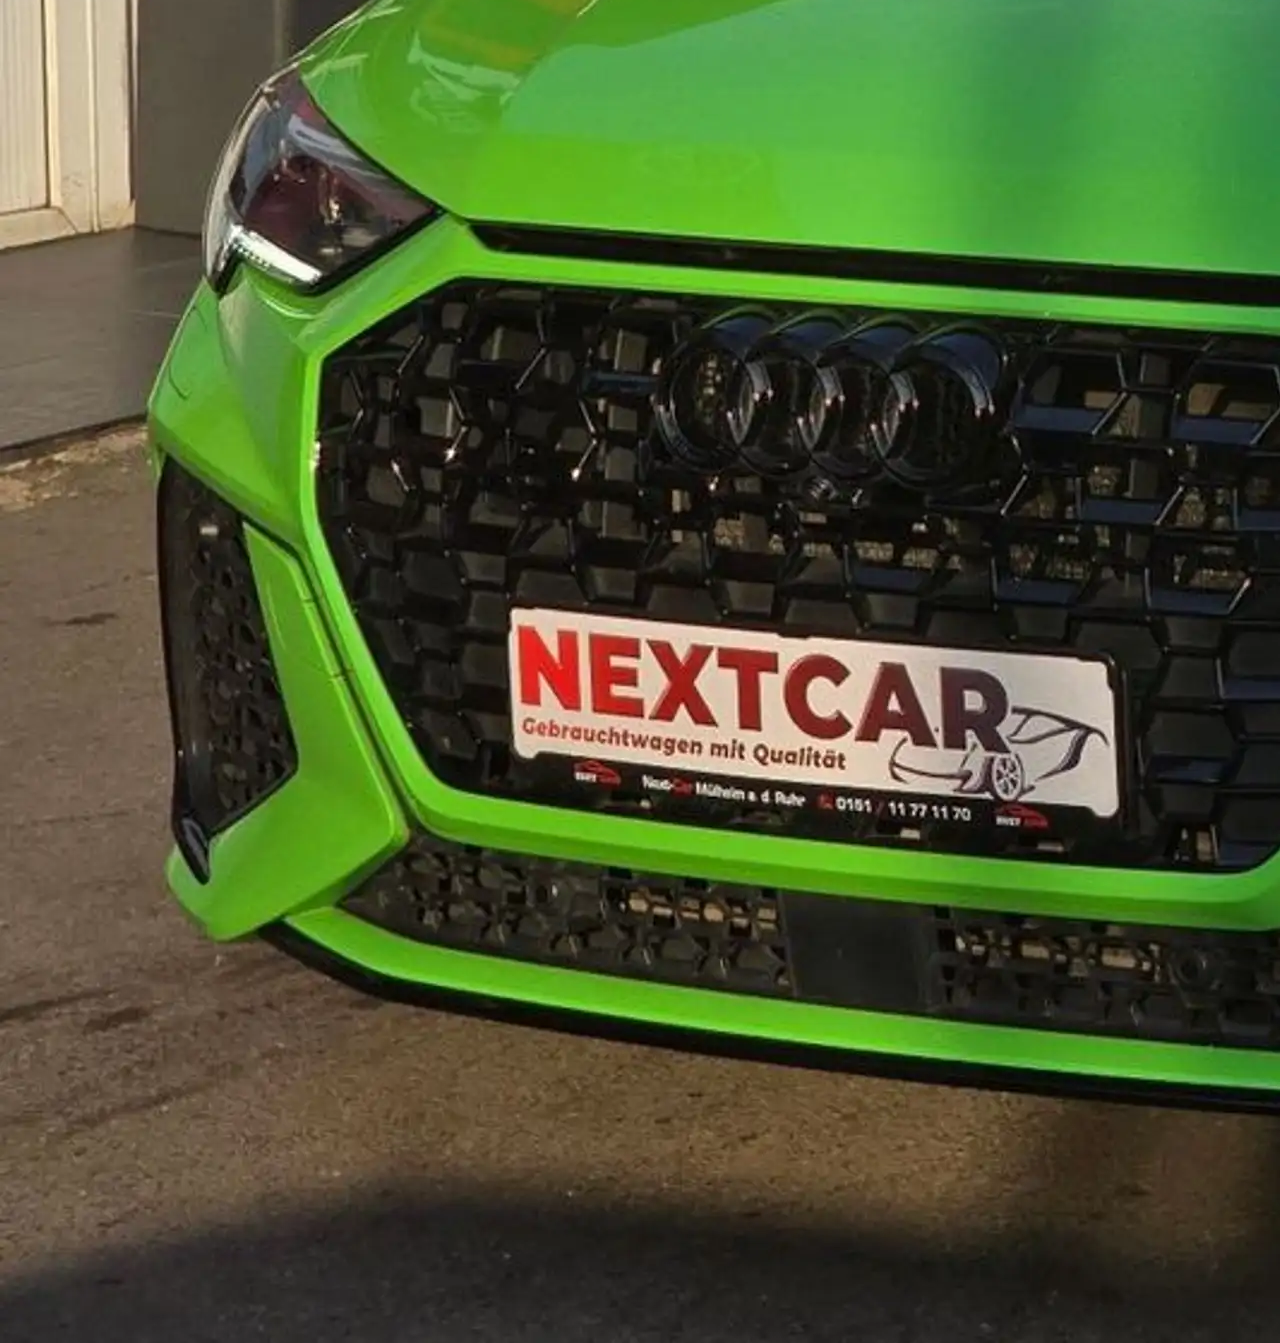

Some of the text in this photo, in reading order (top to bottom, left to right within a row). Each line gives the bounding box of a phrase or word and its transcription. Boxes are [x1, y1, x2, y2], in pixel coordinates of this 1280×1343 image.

[518, 625, 1010, 754] NEXTCAR
[522, 717, 846, 770] Gebrauchtwagen mit Qualität
[909, 802, 928, 818] 77
